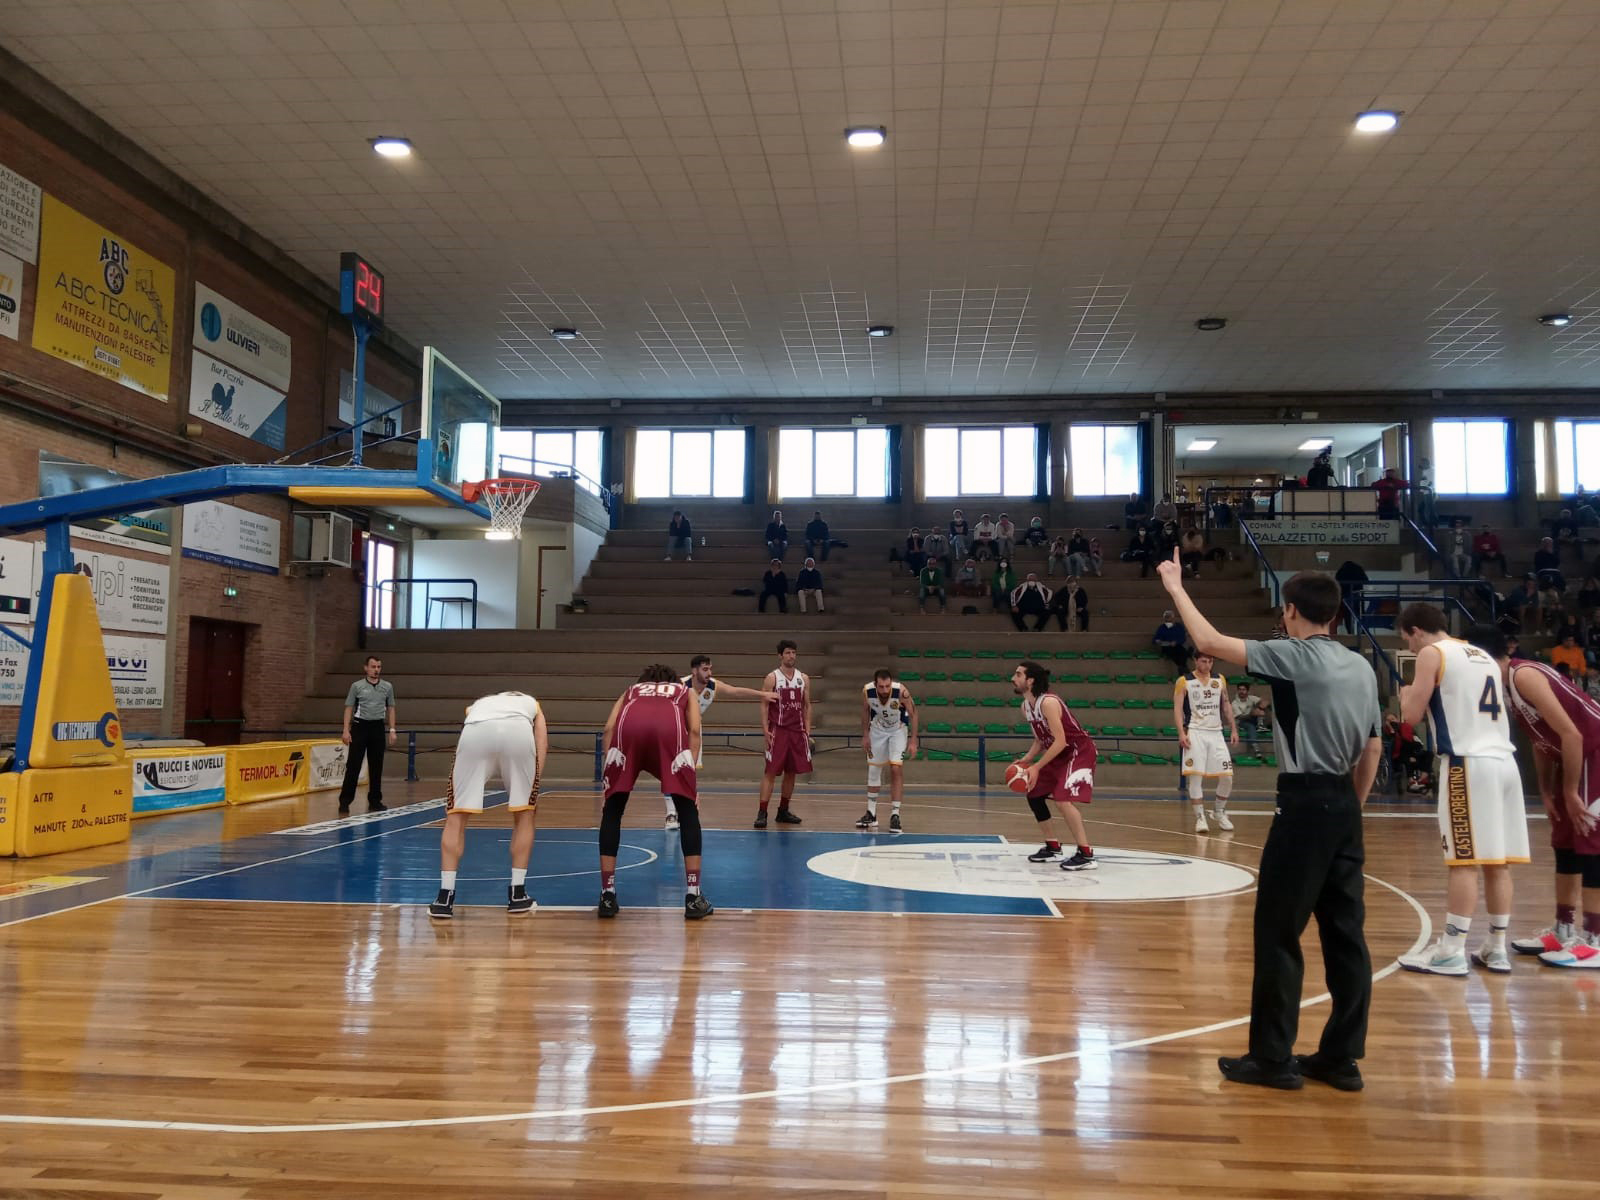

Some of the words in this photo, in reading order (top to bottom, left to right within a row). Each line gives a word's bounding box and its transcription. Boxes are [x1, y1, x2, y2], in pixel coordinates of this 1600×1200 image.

[100, 238, 129, 275] ABC
[356, 261, 382, 316] 24
[55, 271, 97, 305] ABC
[99, 291, 159, 334] TECNICA
[61, 300, 106, 328] ATTREZZI
[108, 322, 121, 335] DA
[55, 312, 118, 350] MANUTENZIONI
[119, 342, 156, 367] PALESTRE
[226, 327, 260, 357] ULIVIERI
[211, 362, 223, 377] Bar
[1250, 522, 1282, 530] COMUNE
[1311, 522, 1391, 530] CASTELFIORENTINO
[1253, 532, 1326, 543] PALAZZETTO
[1351, 532, 1389, 543] SPORT
[133, 576, 160, 586] FRESATURA
[133, 585, 161, 595] TORNITURA
[4, 657, 18, 667] Fax
[638, 684, 676, 695] 20
[1478, 675, 1501, 721] 4
[191, 757, 224, 771] NOVELLI
[1222, 760, 1233, 771] 99
[1452, 765, 1473, 858] CASTELFIORENTINO
[94, 813, 128, 826] PALESTRE
[687, 875, 697, 883] 20
